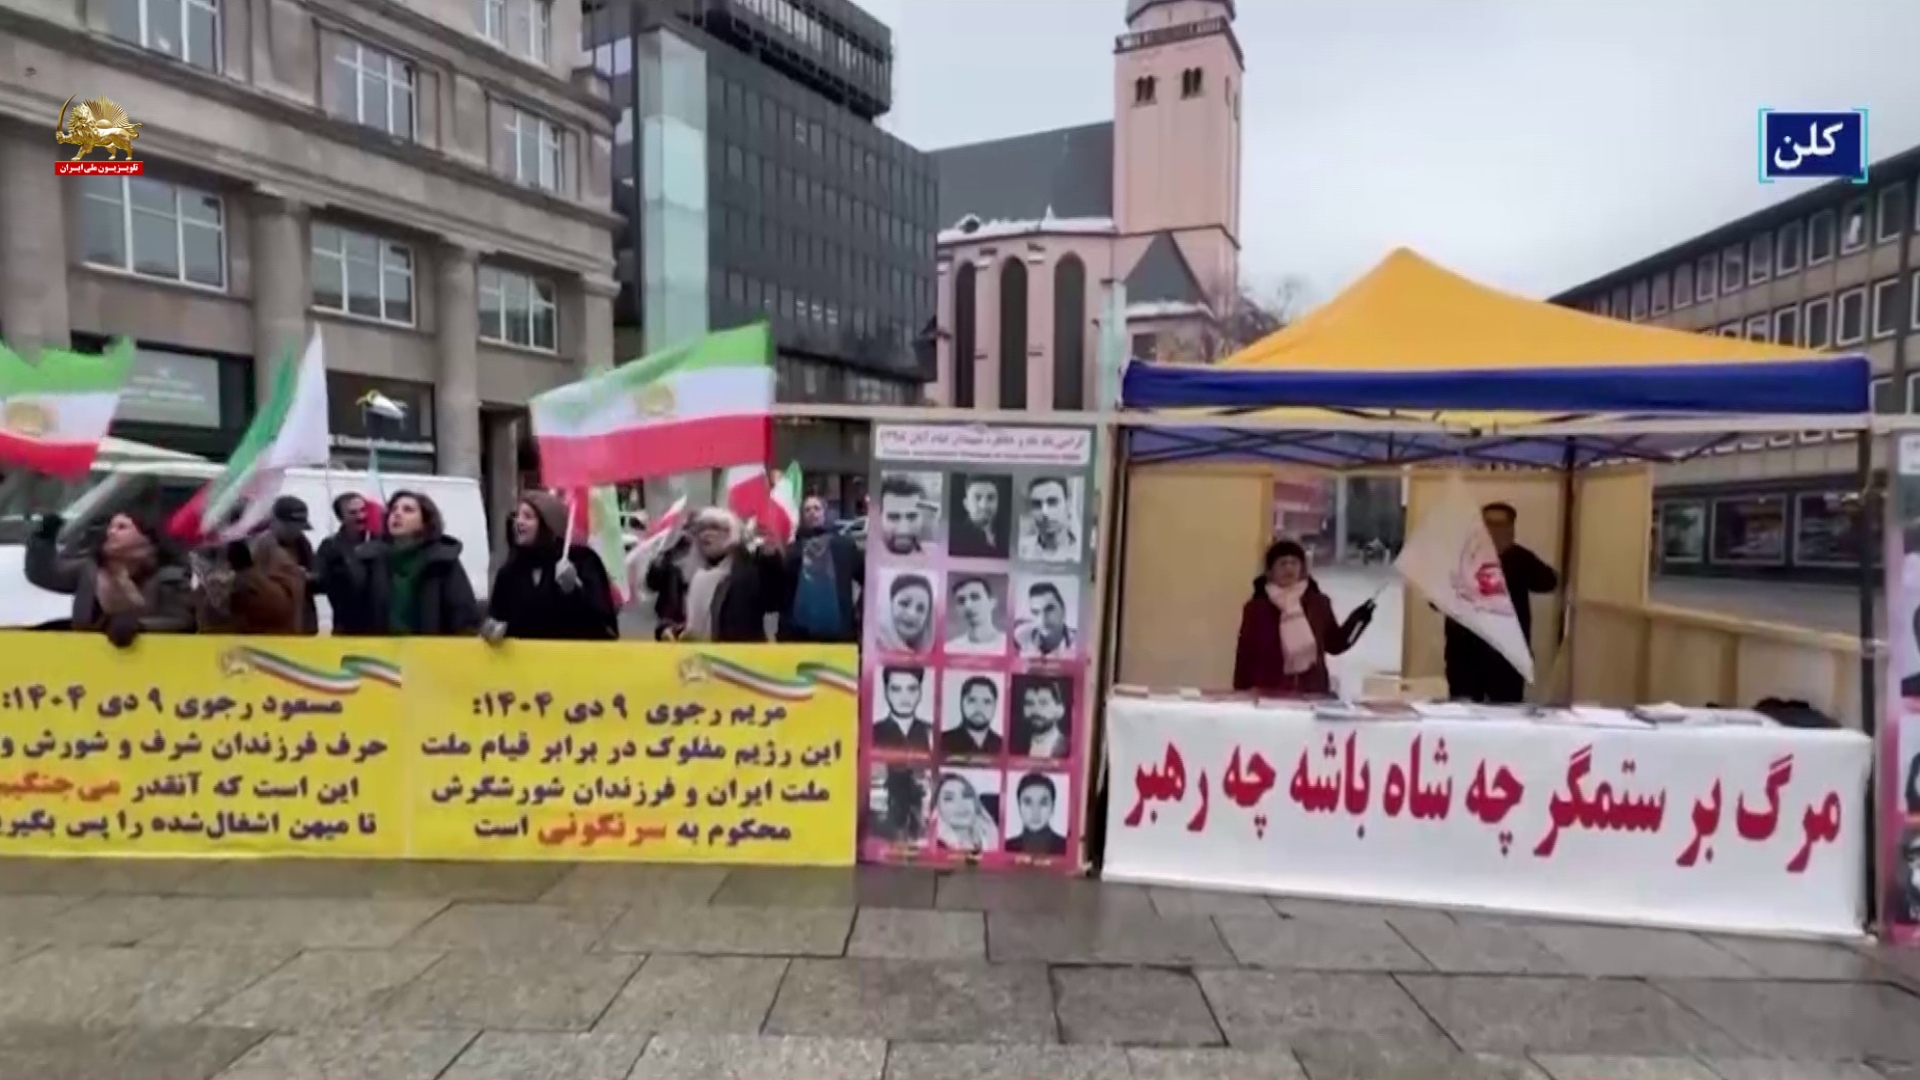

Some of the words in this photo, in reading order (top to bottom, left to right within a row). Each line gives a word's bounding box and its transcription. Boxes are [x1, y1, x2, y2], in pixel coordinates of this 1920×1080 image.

[97, 694, 139, 718] دی
[148, 688, 163, 713] ۹
[175, 696, 253, 721] رجوی
[262, 695, 343, 721] مسعود
[564, 699, 604, 724] دی
[613, 693, 628, 719] ۹
[646, 702, 723, 725] رجوی
[731, 704, 787, 727] مریم
[0, 735, 14, 758] و
[23, 729, 109, 759] شورش
[118, 737, 132, 760] و
[140, 729, 202, 761] شرف
[211, 730, 317, 763] فرزندان
[326, 730, 388, 763] حرف
[421, 732, 472, 756] ملت
[480, 730, 530, 763] قیام
[539, 733, 598, 764] برابر
[606, 739, 637, 765] در
[645, 735, 726, 765] مفلوک
[735, 739, 791, 767] رژیم
[801, 738, 842, 767] این
[131, 770, 203, 803] آنقدر
[213, 774, 244, 796] که
[253, 775, 307, 798] است
[317, 776, 358, 804] این
[431, 774, 565, 805] شورشگرش
[780, 779, 830, 802] ملت
[1123, 741, 1210, 834] رهبر
[1289, 729, 1371, 840] باشه
[1383, 731, 1453, 821] شاه
[573, 776, 676, 808] فرزندان
[685, 787, 698, 808] و
[706, 777, 773, 808] ایران
[1222, 744, 1277, 840] چه
[1465, 756, 1525, 857] چه
[1532, 743, 1667, 858] ستمگر
[0, 809, 55, 839] بگیر
[117, 808, 143, 840] را
[357, 811, 378, 834] تا
[474, 814, 529, 837] است
[1675, 776, 1723, 868] بر
[1736, 753, 1843, 873] مرگ
[66, 815, 109, 841] پس
[288, 818, 349, 841] میهن
[537, 812, 668, 847] سرنگونی
[676, 822, 700, 846] به
[708, 817, 792, 848] محکوم
